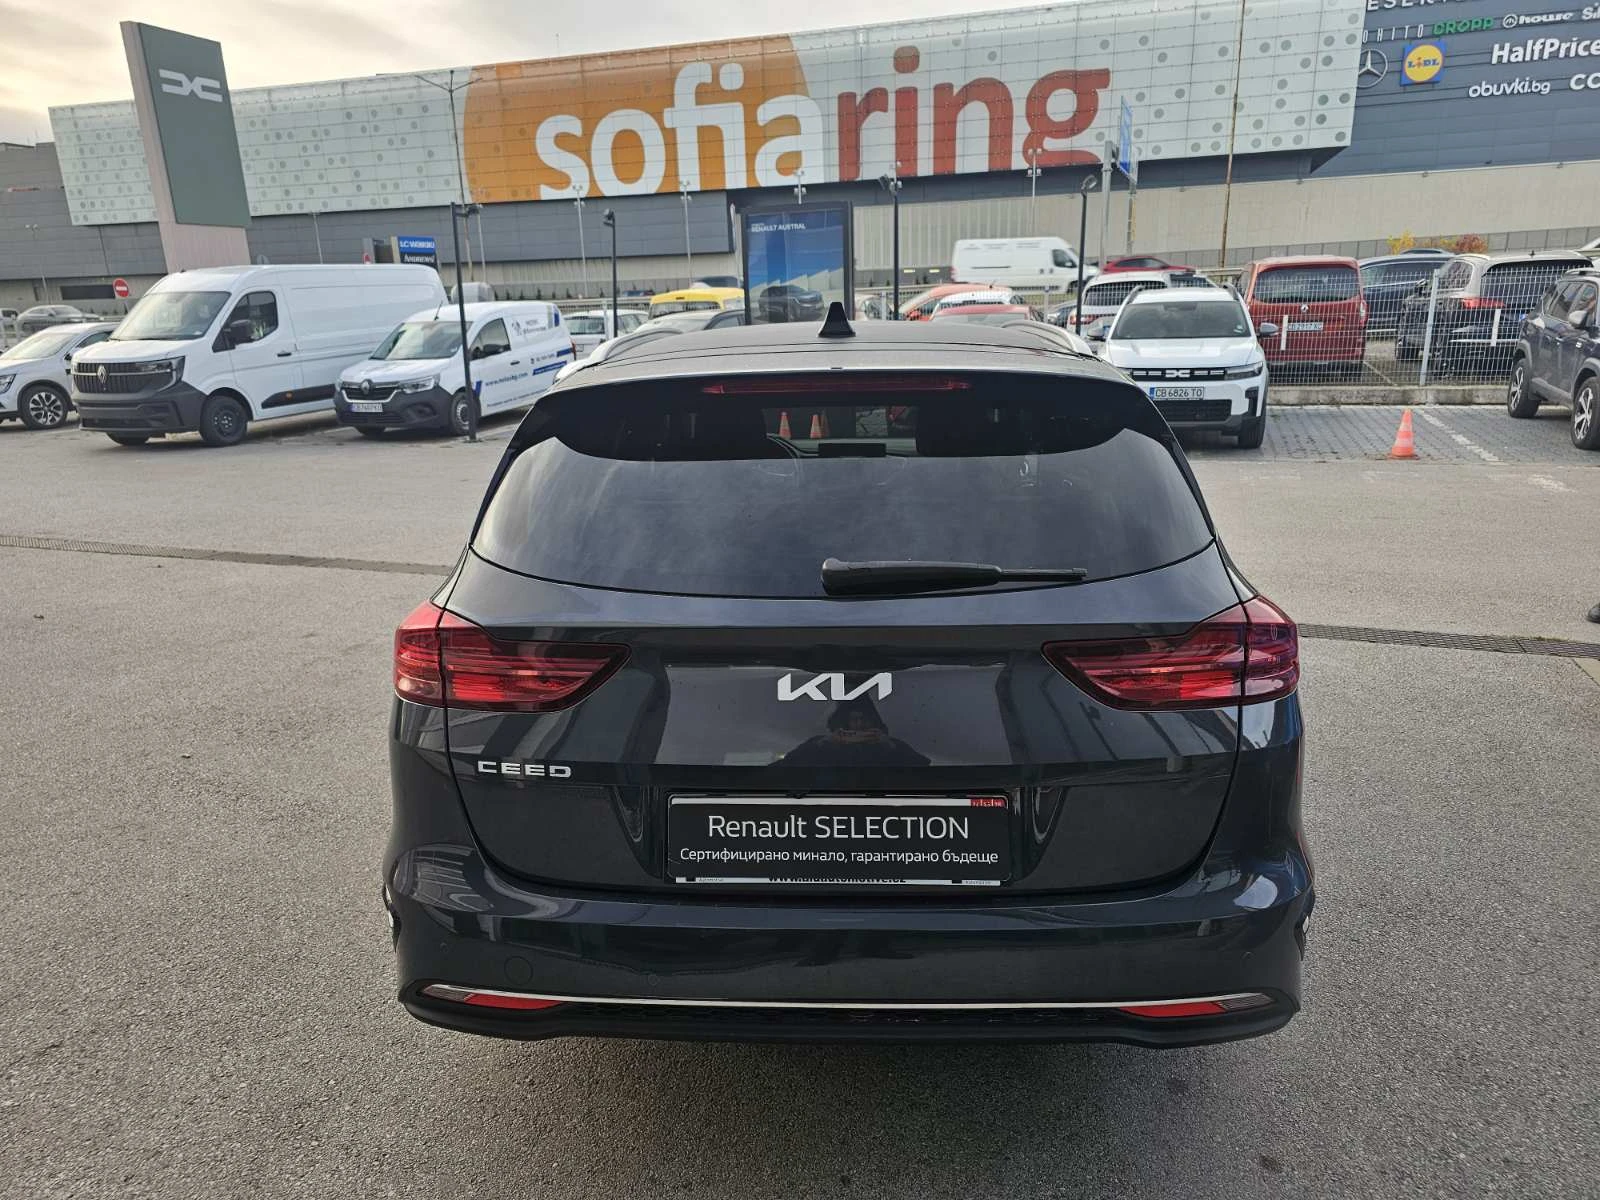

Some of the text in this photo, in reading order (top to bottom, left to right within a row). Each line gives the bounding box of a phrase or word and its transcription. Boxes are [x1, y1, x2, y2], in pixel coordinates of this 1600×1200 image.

[1362, 24, 1424, 44] OHITO
[1491, 37, 1600, 65] HalfPrice
[1469, 77, 1551, 98] obuvki.bg
[478, 761, 571, 778] CEED
[708, 815, 969, 839] Renault SELECTION
[680, 848, 999, 864] Сертифицирано минало, гарантирано бъдеще
